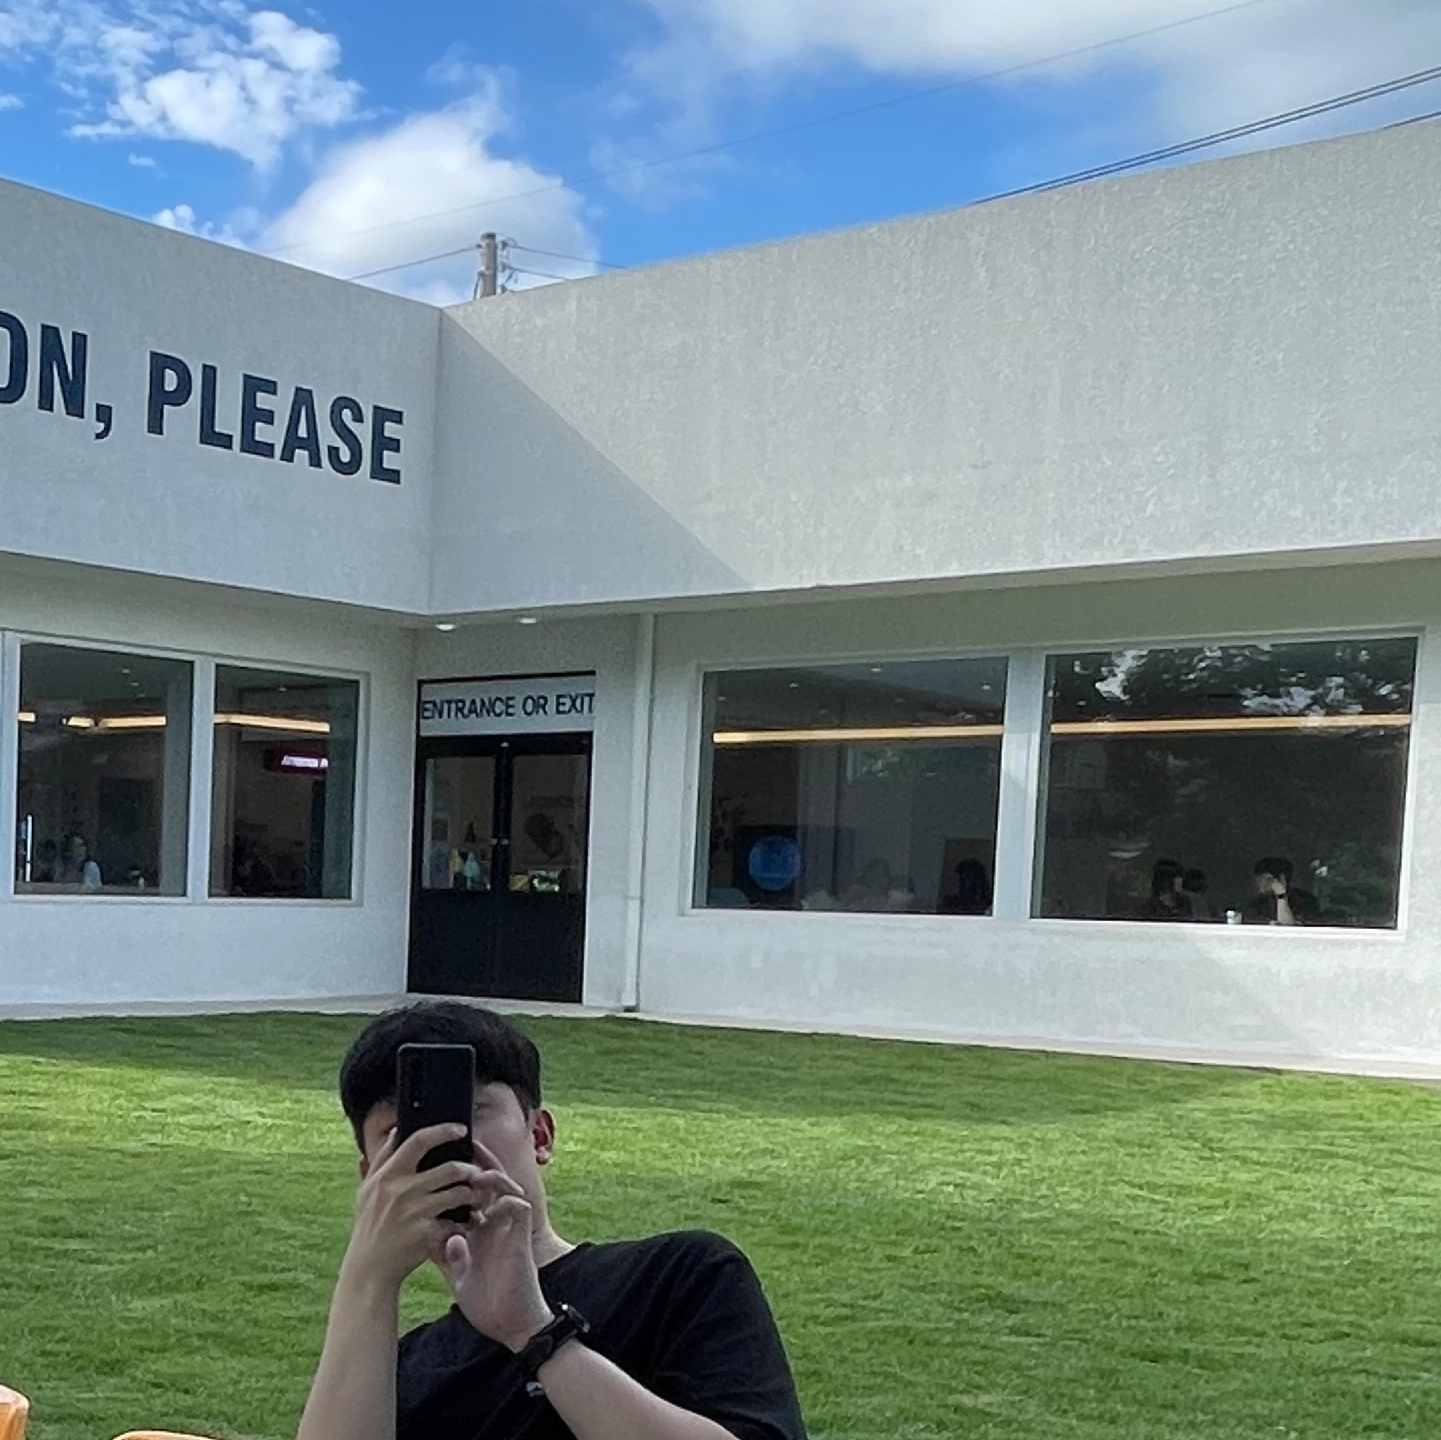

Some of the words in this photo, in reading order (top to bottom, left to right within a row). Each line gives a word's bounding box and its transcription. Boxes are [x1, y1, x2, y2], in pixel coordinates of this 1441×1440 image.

[147, 351, 404, 485] PLEASE
[421, 696, 517, 719] ENTRANCE
[522, 694, 548, 716] OR
[555, 691, 595, 715] EXIT
